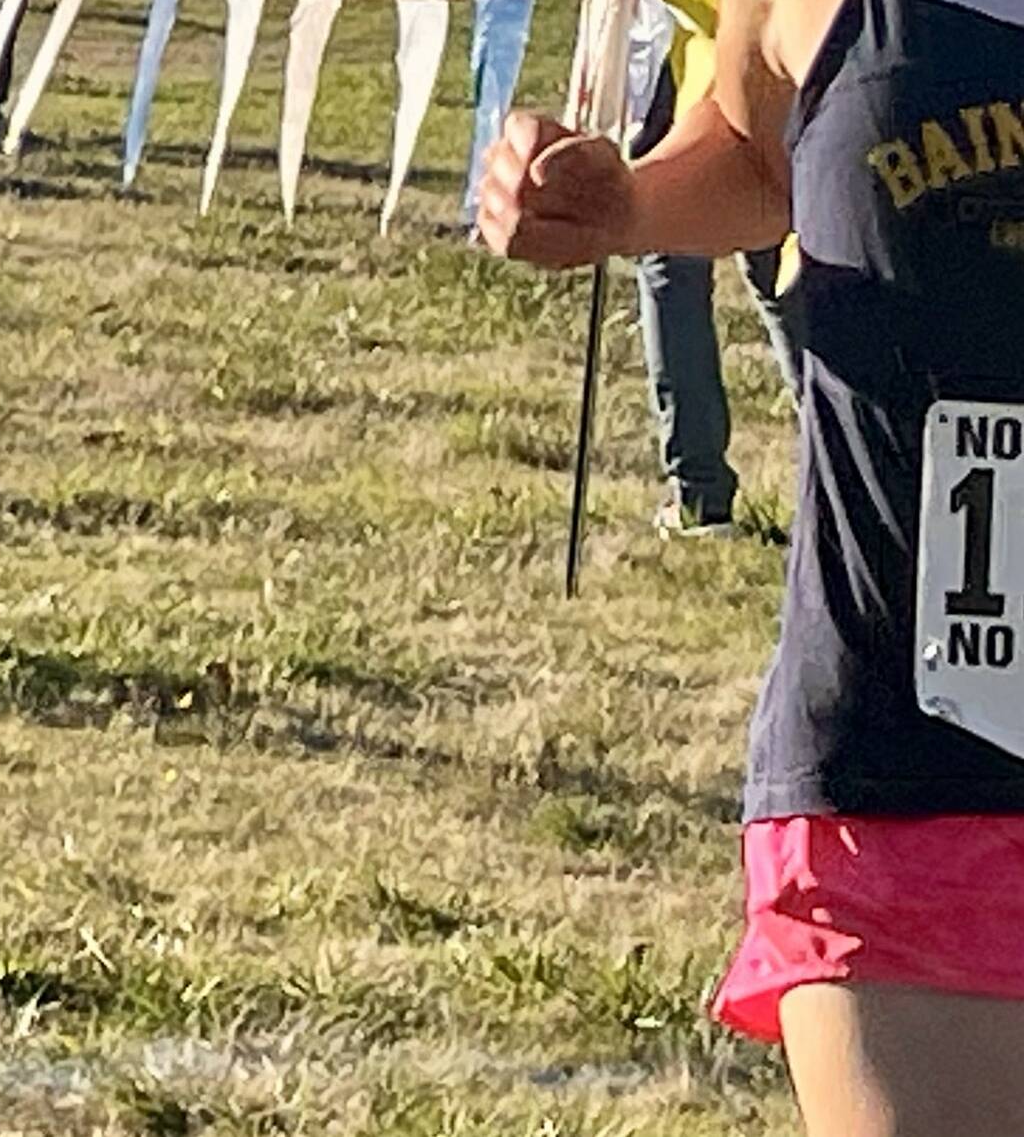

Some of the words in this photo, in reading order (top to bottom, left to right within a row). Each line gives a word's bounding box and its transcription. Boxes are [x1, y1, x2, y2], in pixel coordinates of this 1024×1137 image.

[956, 415, 1022, 460] NO
[944, 467, 1005, 618] 1
[947, 622, 1014, 669] NO
